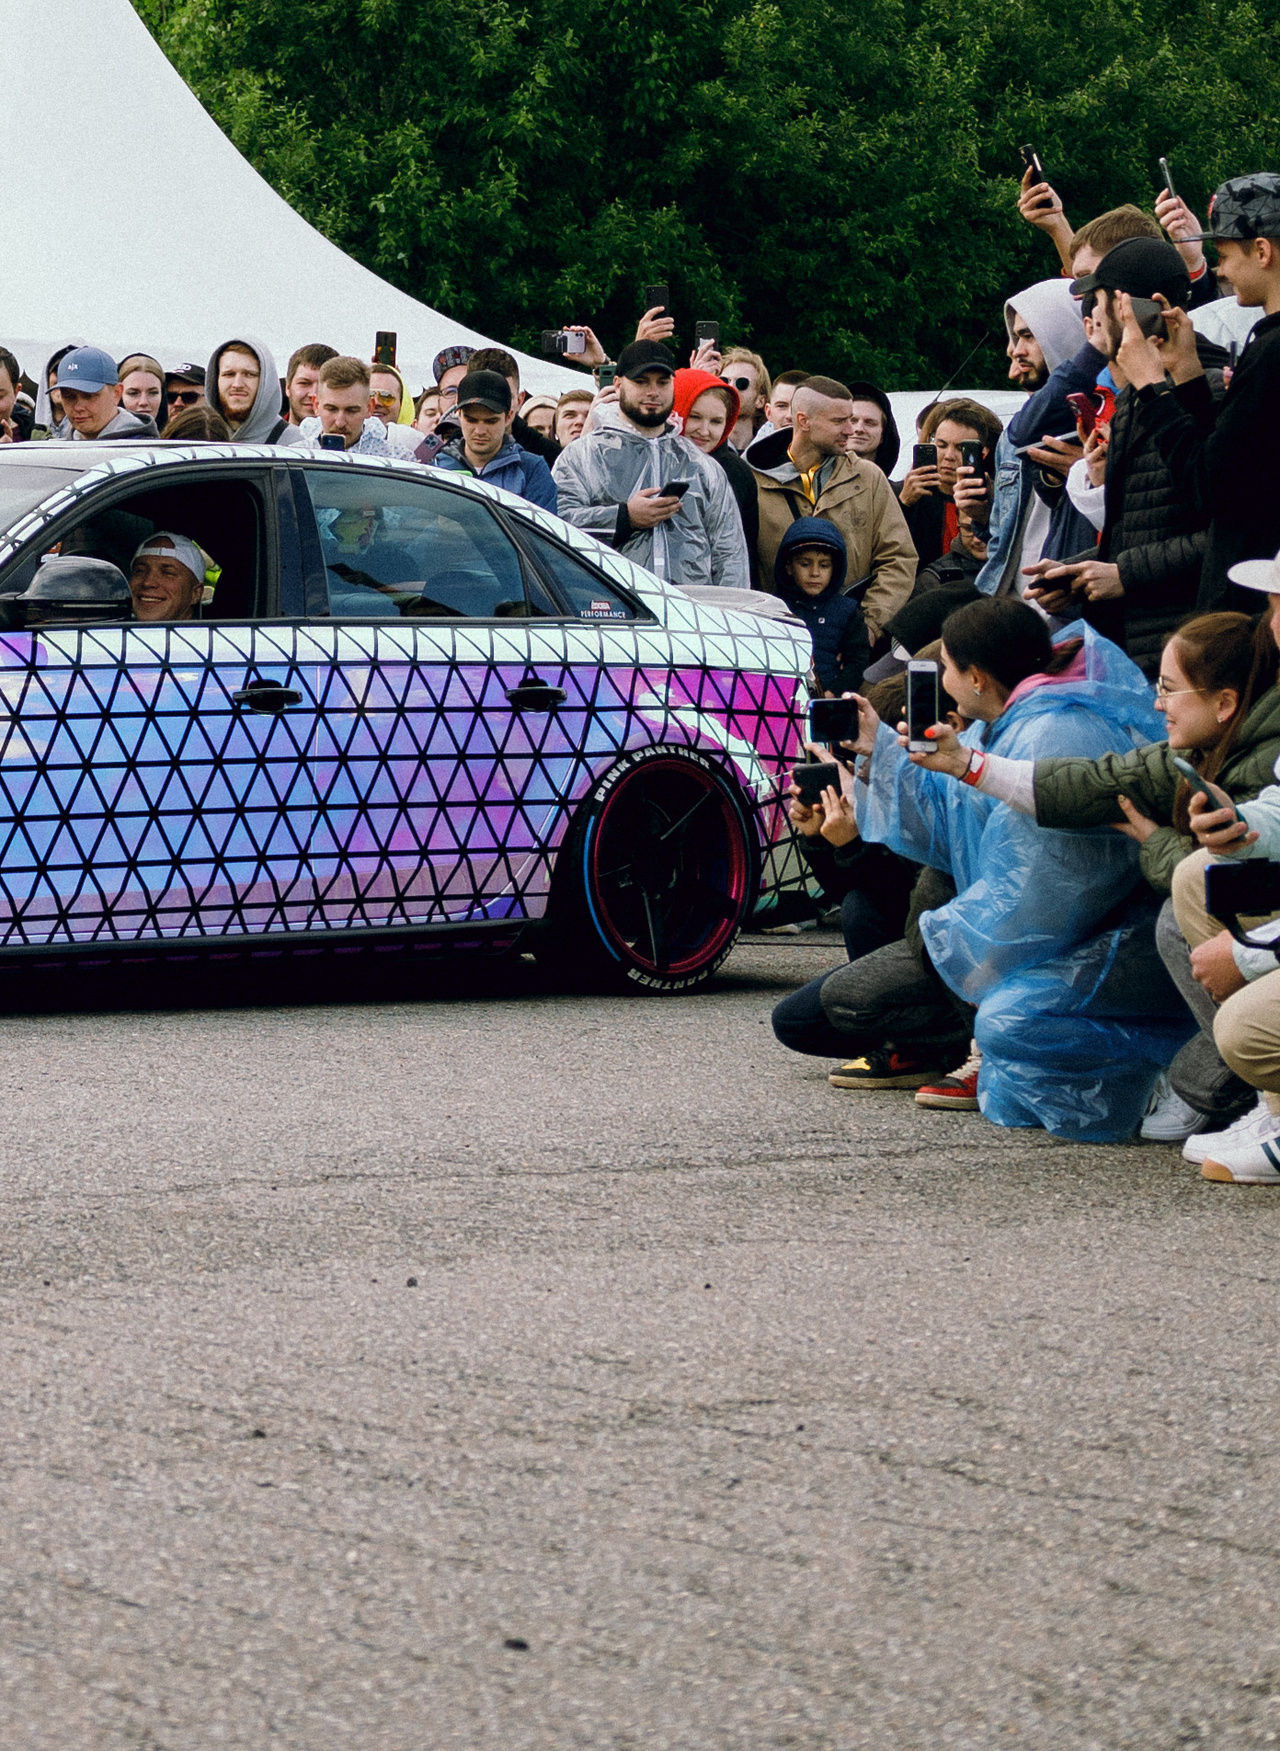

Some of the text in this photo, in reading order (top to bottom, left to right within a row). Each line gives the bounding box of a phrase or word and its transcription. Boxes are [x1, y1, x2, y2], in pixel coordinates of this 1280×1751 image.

[580, 610, 626, 619] PERFORMANCE
[594, 745, 710, 802] PINK PANTHER
